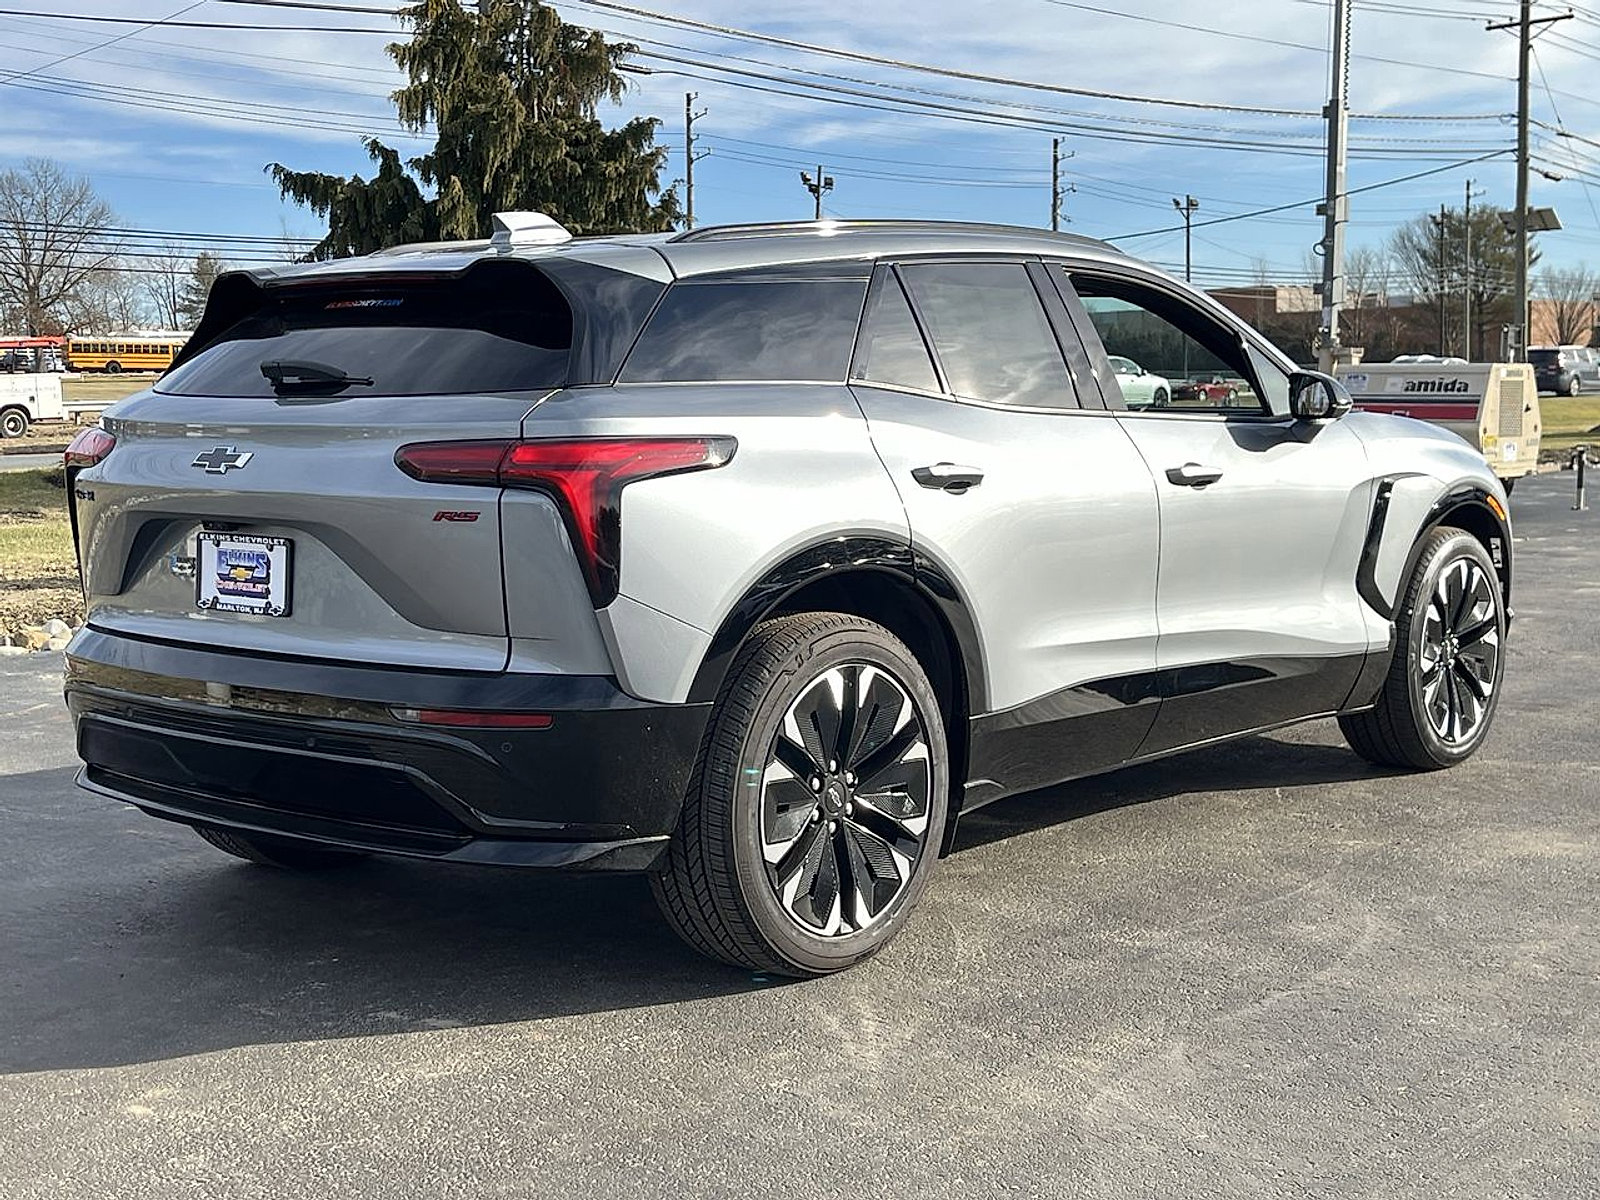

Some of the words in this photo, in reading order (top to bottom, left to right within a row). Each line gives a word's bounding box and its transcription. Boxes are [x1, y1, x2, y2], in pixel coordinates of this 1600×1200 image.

[1404, 377, 1469, 393] amida
[432, 511, 481, 522] RS
[200, 533, 231, 542] ELKINS
[233, 535, 285, 545] CHEVROLET
[217, 548, 267, 577] ELKINS
